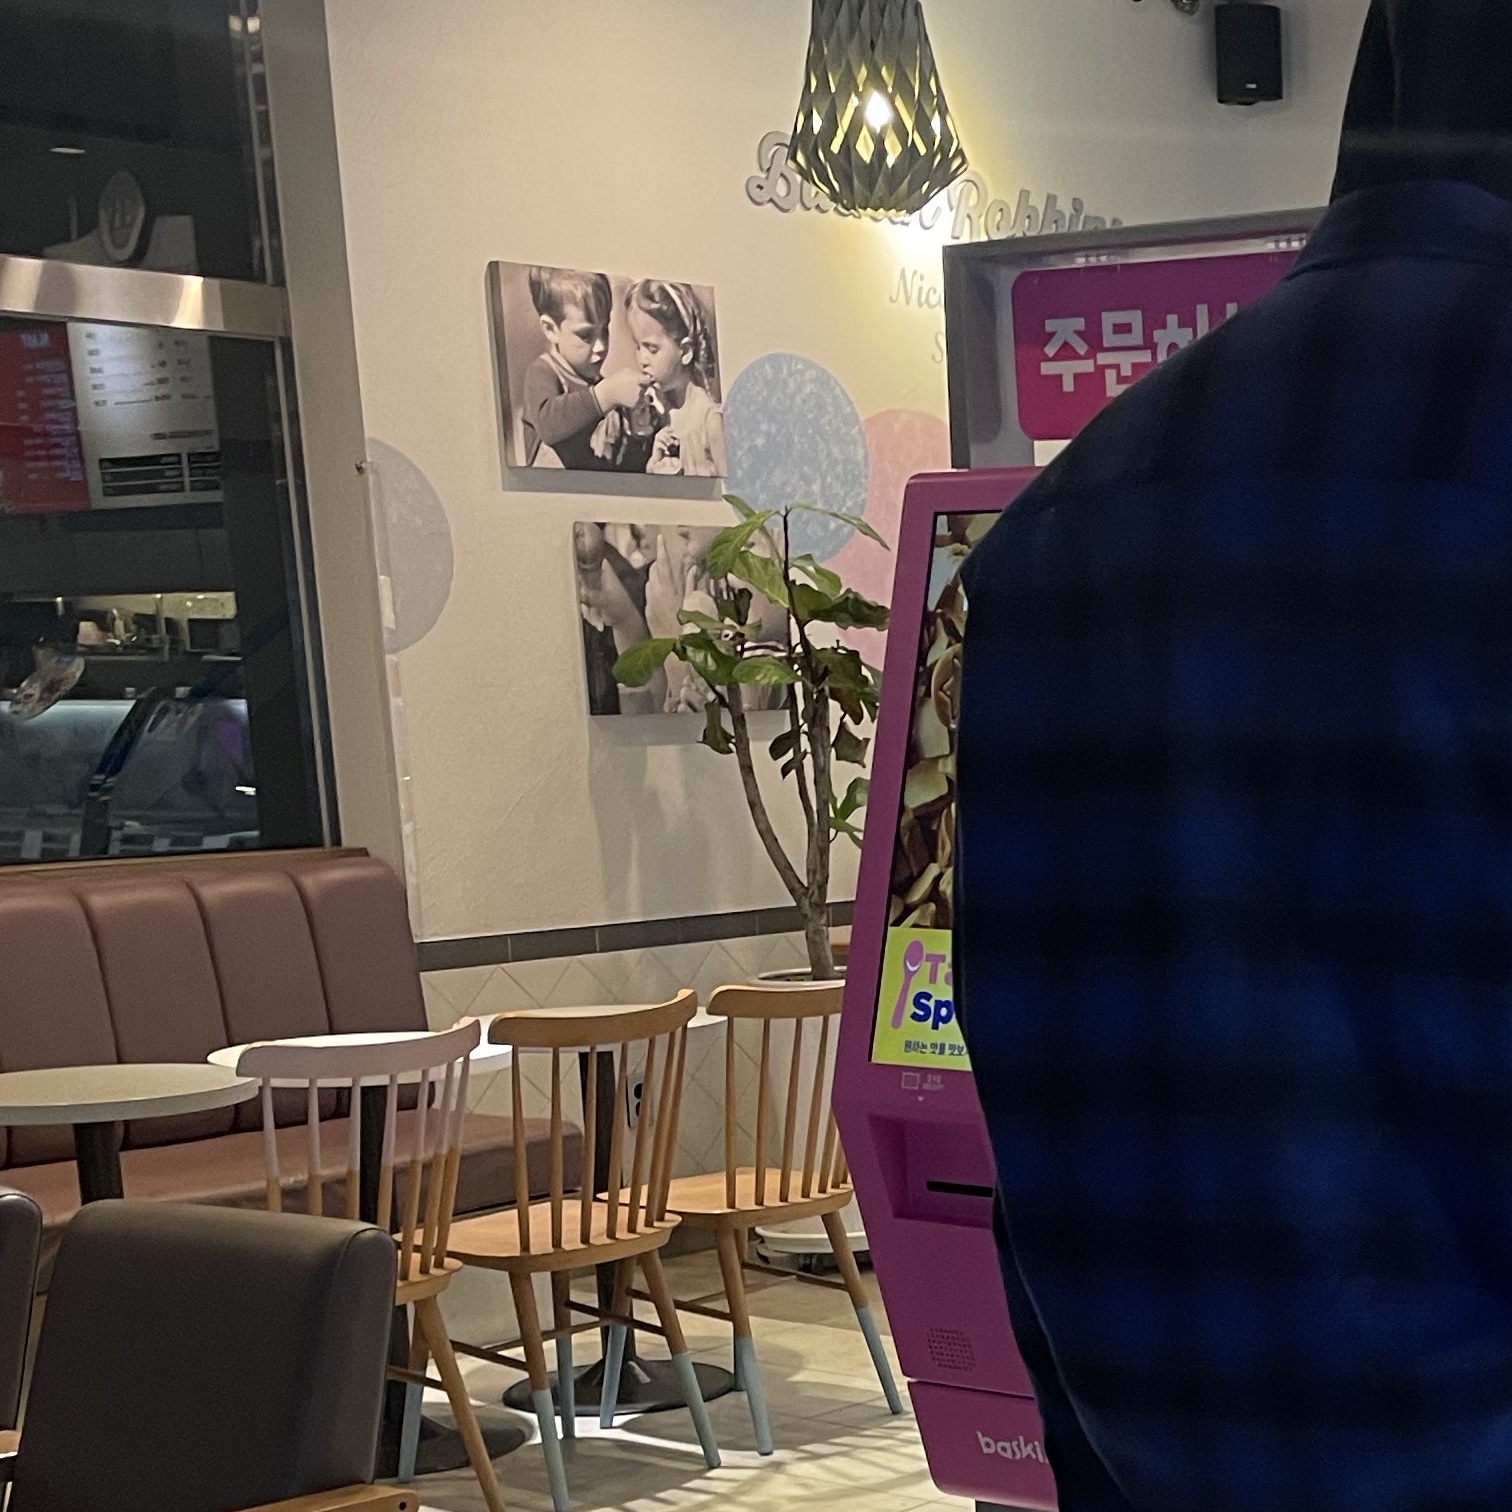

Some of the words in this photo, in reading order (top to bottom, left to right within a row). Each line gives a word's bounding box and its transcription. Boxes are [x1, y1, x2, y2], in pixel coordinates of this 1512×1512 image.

[1040, 302, 1238, 398] 주문하
[948, 1043, 968, 1056] 맛보
[976, 1430, 1048, 1464] baski
